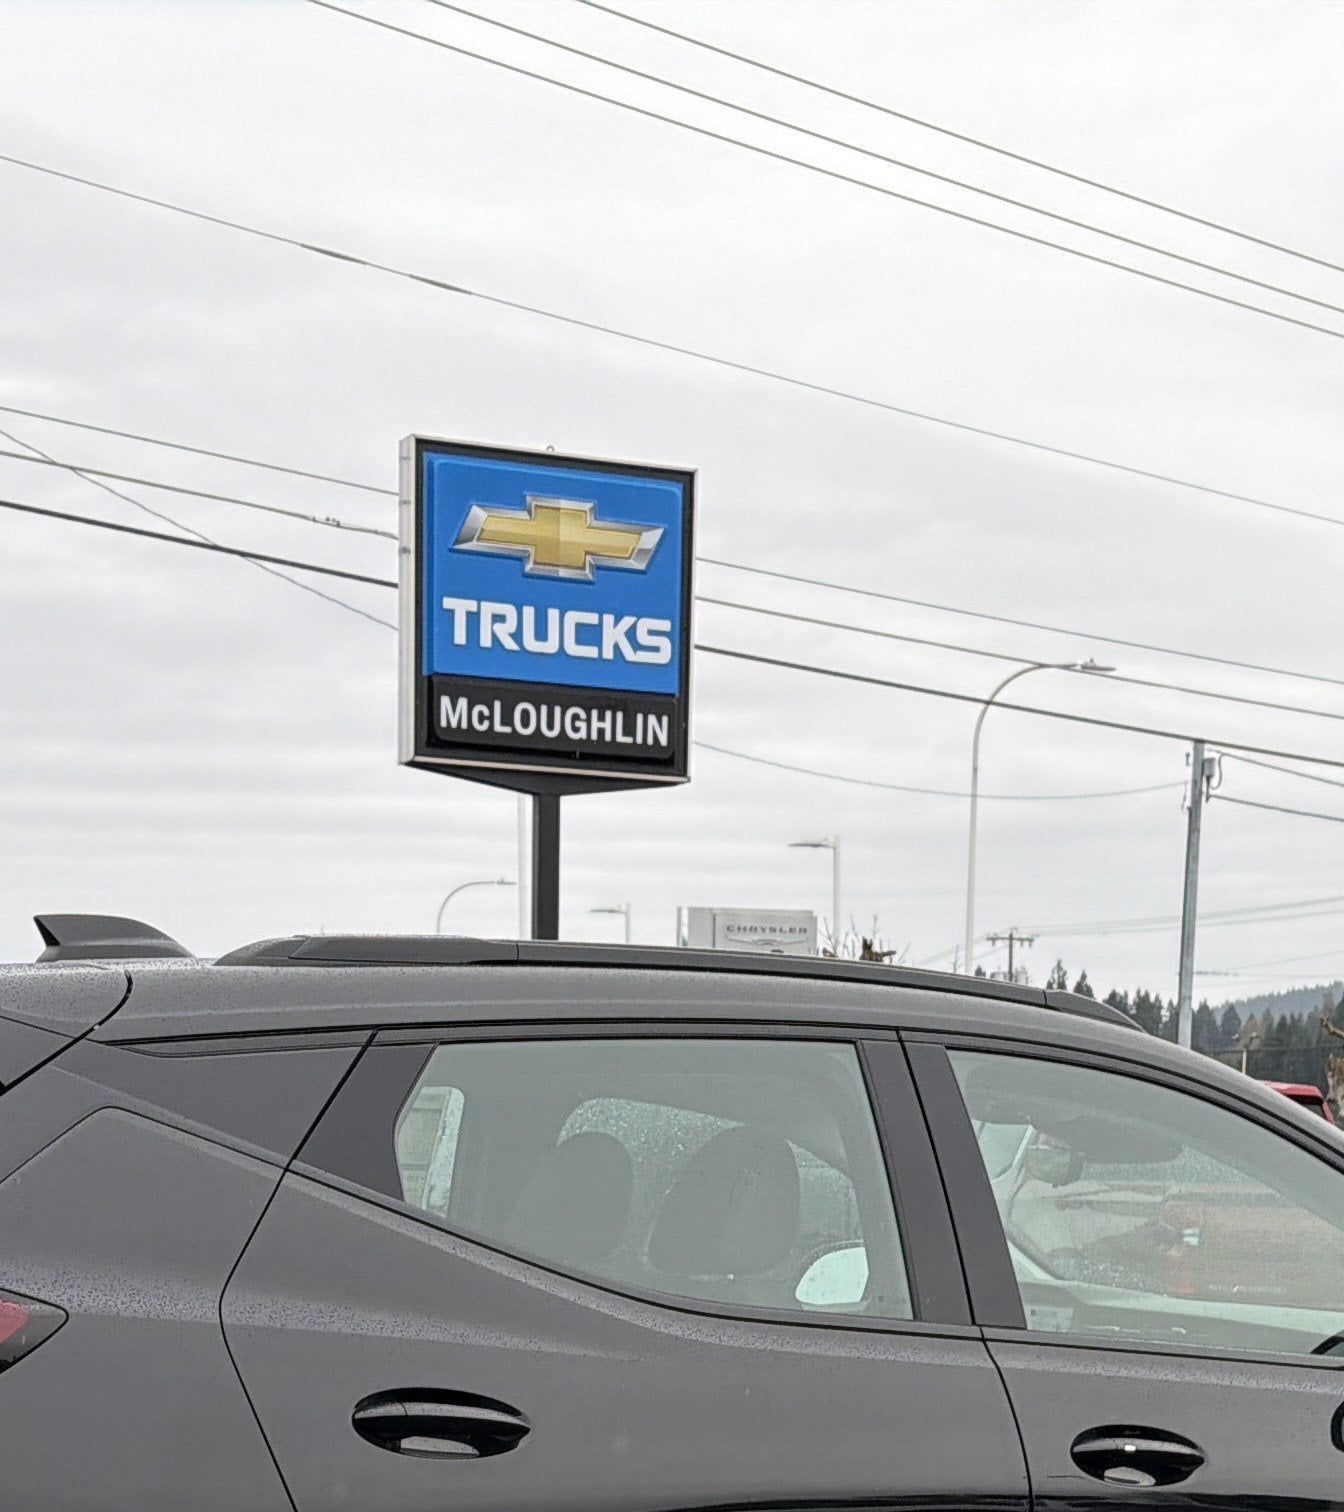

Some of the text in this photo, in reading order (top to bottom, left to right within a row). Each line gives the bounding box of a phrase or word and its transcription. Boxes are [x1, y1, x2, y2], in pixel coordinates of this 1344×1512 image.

[442, 596, 672, 665] TRUCKS
[439, 695, 669, 747] McLOUGHLIN
[726, 924, 808, 935] CHRYSLER
